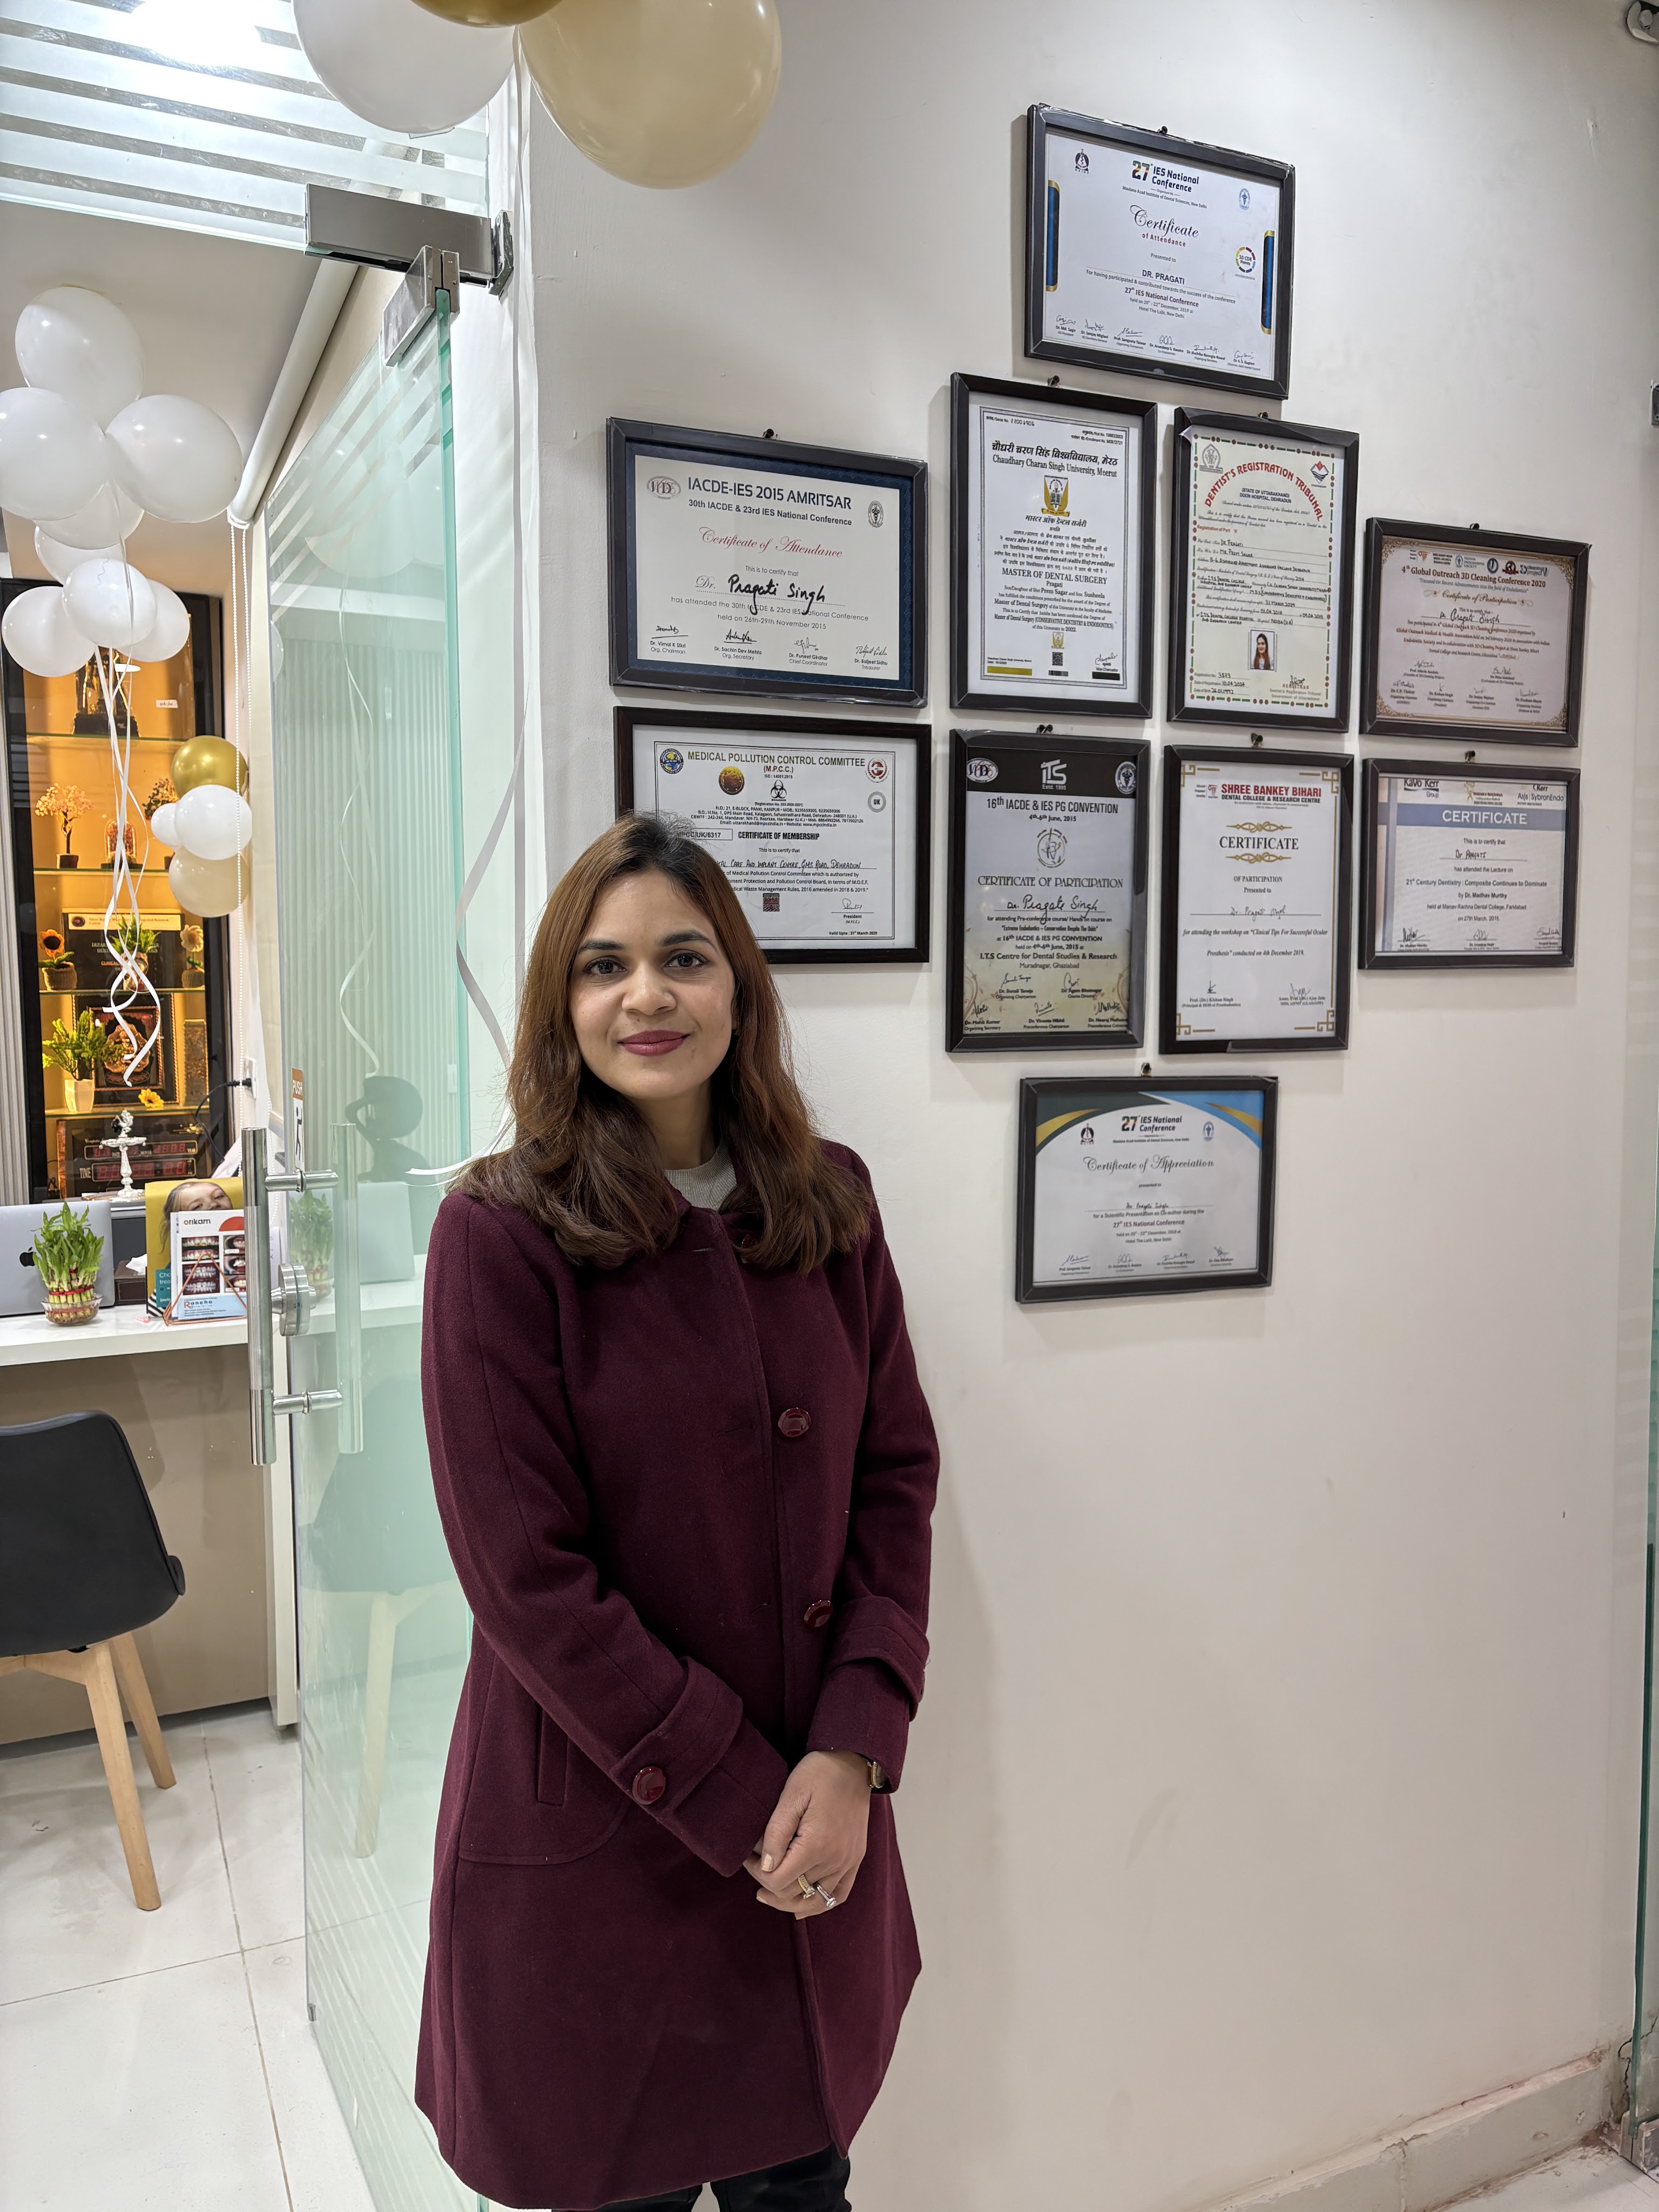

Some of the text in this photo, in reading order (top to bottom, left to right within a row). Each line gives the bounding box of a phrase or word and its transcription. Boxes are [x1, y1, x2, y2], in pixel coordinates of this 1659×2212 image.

[1153, 166, 1199, 185] IES National
[1152, 176, 1192, 192] Conference
[1130, 205, 1198, 238] Certificate
[1150, 234, 1186, 247] Attendance
[1150, 252, 1171, 262] Presented
[1142, 269, 1185, 285] DR. PRAGATI
[1094, 270, 1108, 280] having
[1108, 275, 1134, 284] participated
[1138, 280, 1162, 289] contributed
[1214, 296, 1236, 304] conference
[1145, 291, 1169, 301] National
[1169, 296, 1199, 307] Conference
[1015, 446, 1035, 455] चरण
[1035, 446, 1051, 458] सिंह
[1102, 454, 1119, 466] मेरठ
[993, 454, 1117, 477] Chaudhary Charan Singh University, Meerut
[688, 477, 852, 510] IACDE-IES 2015 AMRITSAR
[1204, 469, 1236, 507] DENTIST'S
[1237, 462, 1294, 481] REGISTRATION
[1295, 477, 1323, 521] TRIBUNAL
[689, 499, 852, 525] 30th IACDE & 23rd IES National Conference
[1071, 519, 1087, 528] सर्जरी
[699, 527, 842, 557] Certificate of Attendance
[1002, 567, 1108, 585] MASTER OF DENTAL SURGERY
[1411, 567, 1431, 576] Global
[1432, 569, 1460, 579] Outreach
[1461, 572, 1469, 580] 3D
[1471, 573, 1497, 584] Cleaning
[1498, 576, 1530, 586] Conference
[1531, 579, 1546, 588] 2020
[1046, 580, 1063, 589] Pragati
[696, 574, 825, 615] Dr. Pragati Singh
[744, 616, 774, 625] 26th-29th
[776, 619, 810, 628] November
[687, 751, 866, 767] MEDICAL POLLUTION CONTROL COMMITTEE
[763, 765, 794, 774] (M.P.C.C.)
[1221, 784, 1251, 794] SHREE
[1253, 785, 1290, 796] BANKEY
[1292, 787, 1321, 797] BIHARI
[1404, 778, 1421, 787] KaVo
[1426, 791, 1439, 799] Group
[987, 796, 1118, 814] 16th IACDE & IES PG CONVENTION
[1442, 810, 1527, 825] CERTIFICATE
[738, 831, 773, 839] CERTIFICATE
[782, 832, 820, 840] MEMBERSHIP
[1219, 836, 1299, 850] CERTIFICATE
[977, 875, 1123, 888] CERTIFICATE OF PARTICIPATION
[1019, 962, 1051, 970] Muradnagar,
[293, 1080, 302, 1095] PUSH
[1140, 1115, 1182, 1124] IES National
[1139, 1124, 1176, 1134] Conference
[1083, 1155, 1215, 1175] Certificate of Appreciation
